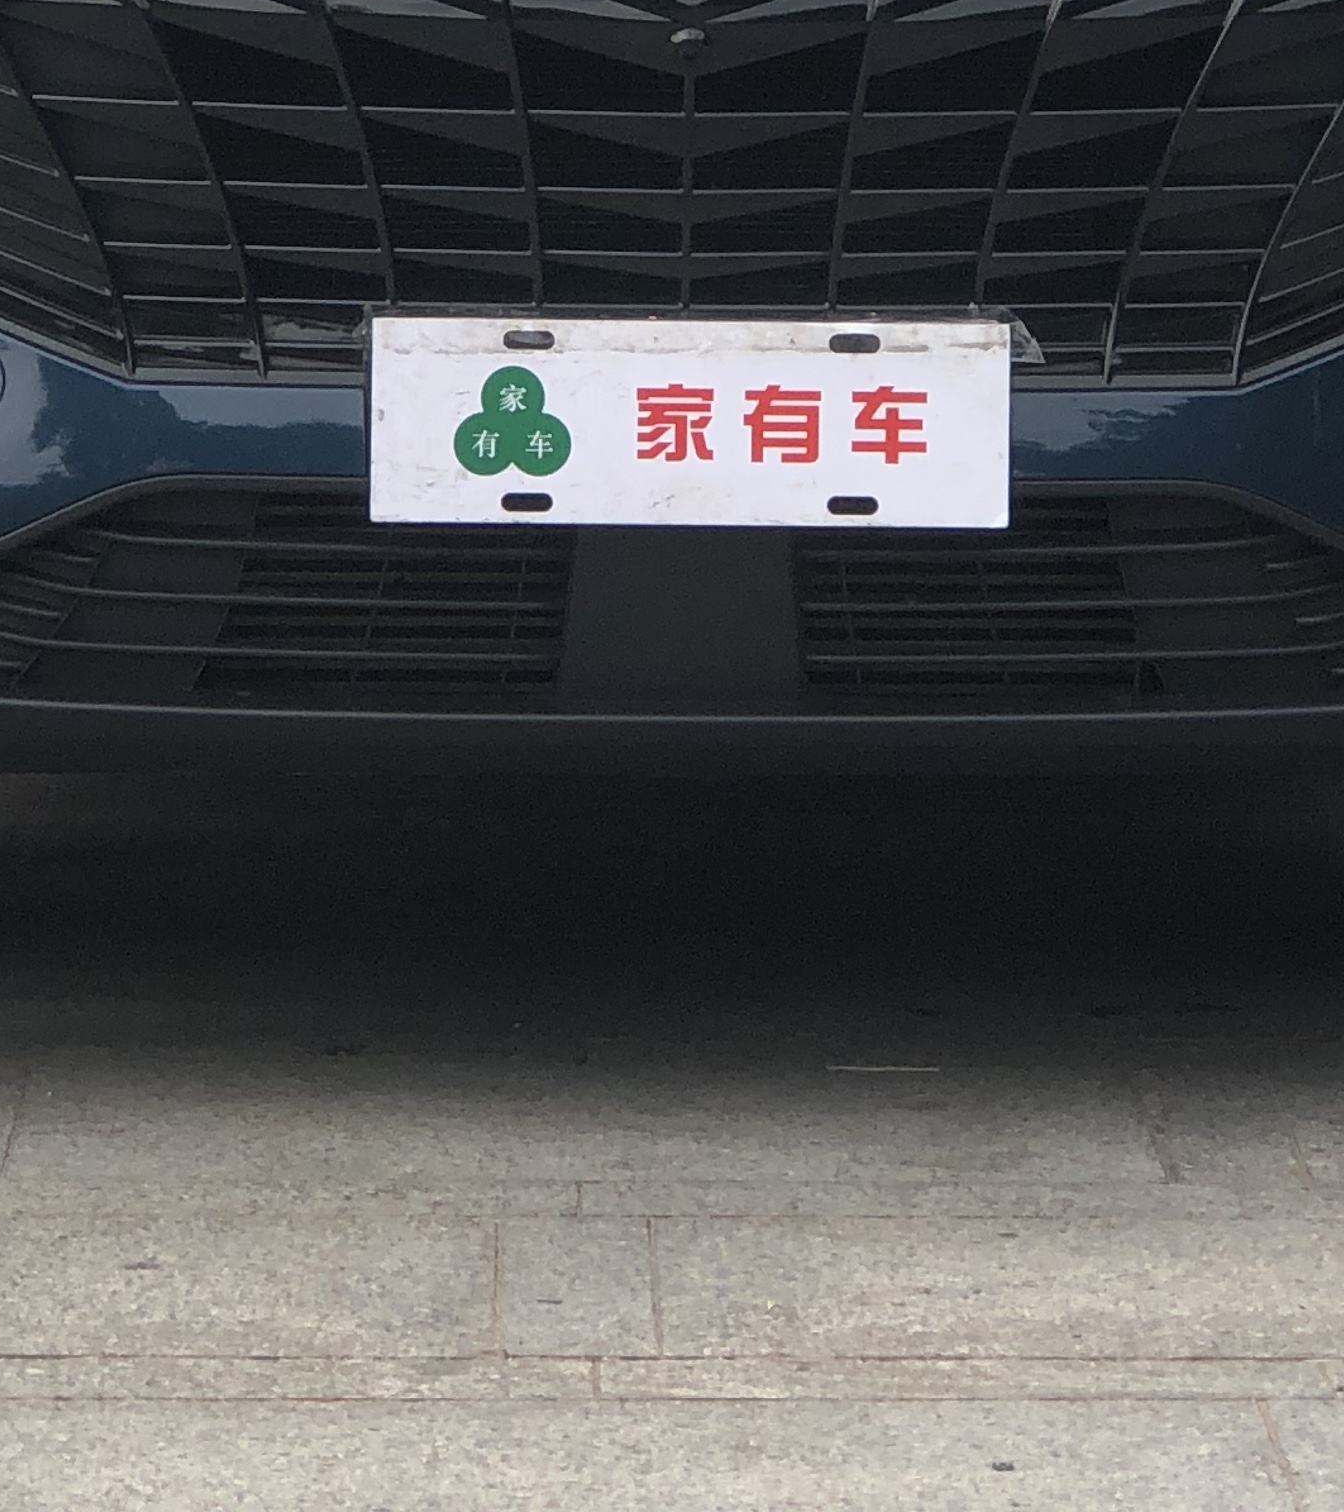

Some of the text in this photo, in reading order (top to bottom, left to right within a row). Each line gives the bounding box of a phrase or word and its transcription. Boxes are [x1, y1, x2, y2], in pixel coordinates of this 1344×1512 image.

[499, 384, 527, 413] 家
[635, 383, 929, 465] 家有车
[471, 429, 554, 460] 有 车
